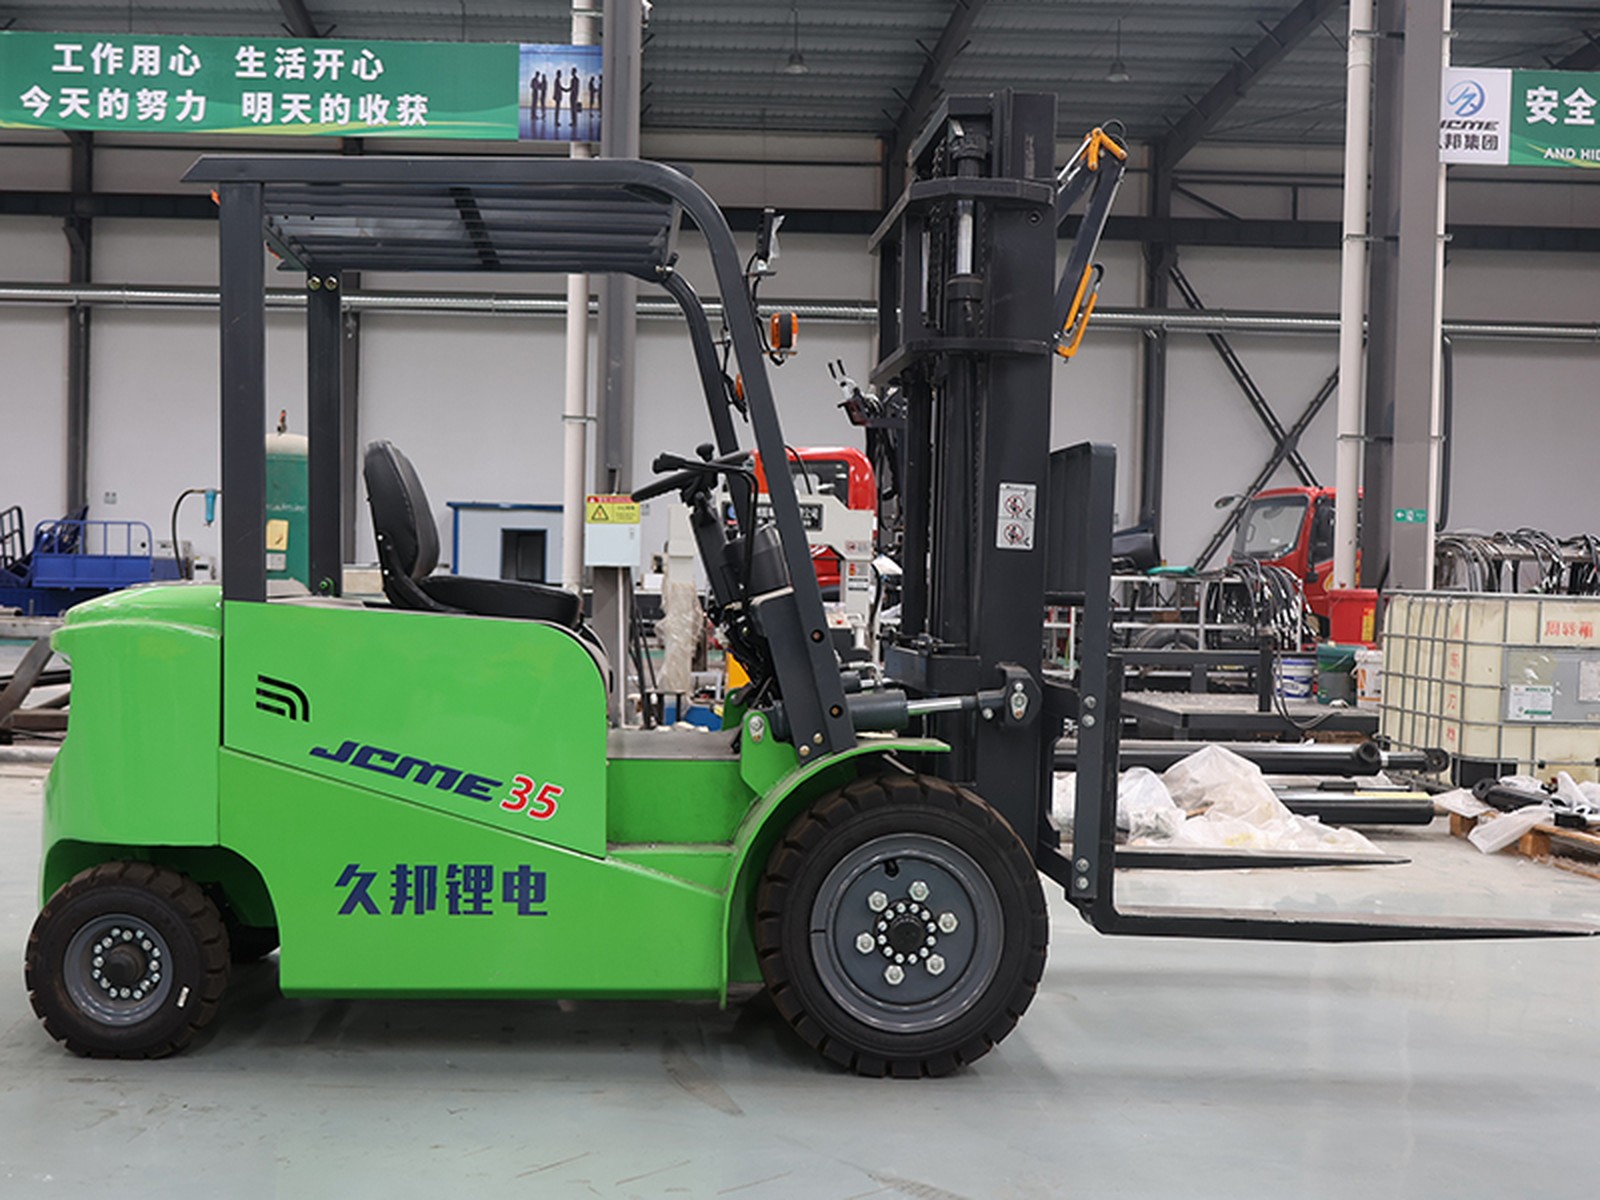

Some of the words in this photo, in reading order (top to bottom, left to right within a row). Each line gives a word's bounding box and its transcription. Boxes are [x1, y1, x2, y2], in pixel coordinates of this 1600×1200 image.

[52, 42, 202, 77] 工作用心
[235, 46, 384, 81] 生活开心
[20, 86, 207, 120] 今天的努力
[241, 92, 429, 126] 明天的收获
[1525, 85, 1597, 125] 安全
[1439, 133, 1499, 151] 邦集团
[1543, 147, 1576, 160] AND
[309, 740, 503, 802] JCME
[501, 773, 564, 819] 35
[335, 863, 548, 917] 久邦锂电
